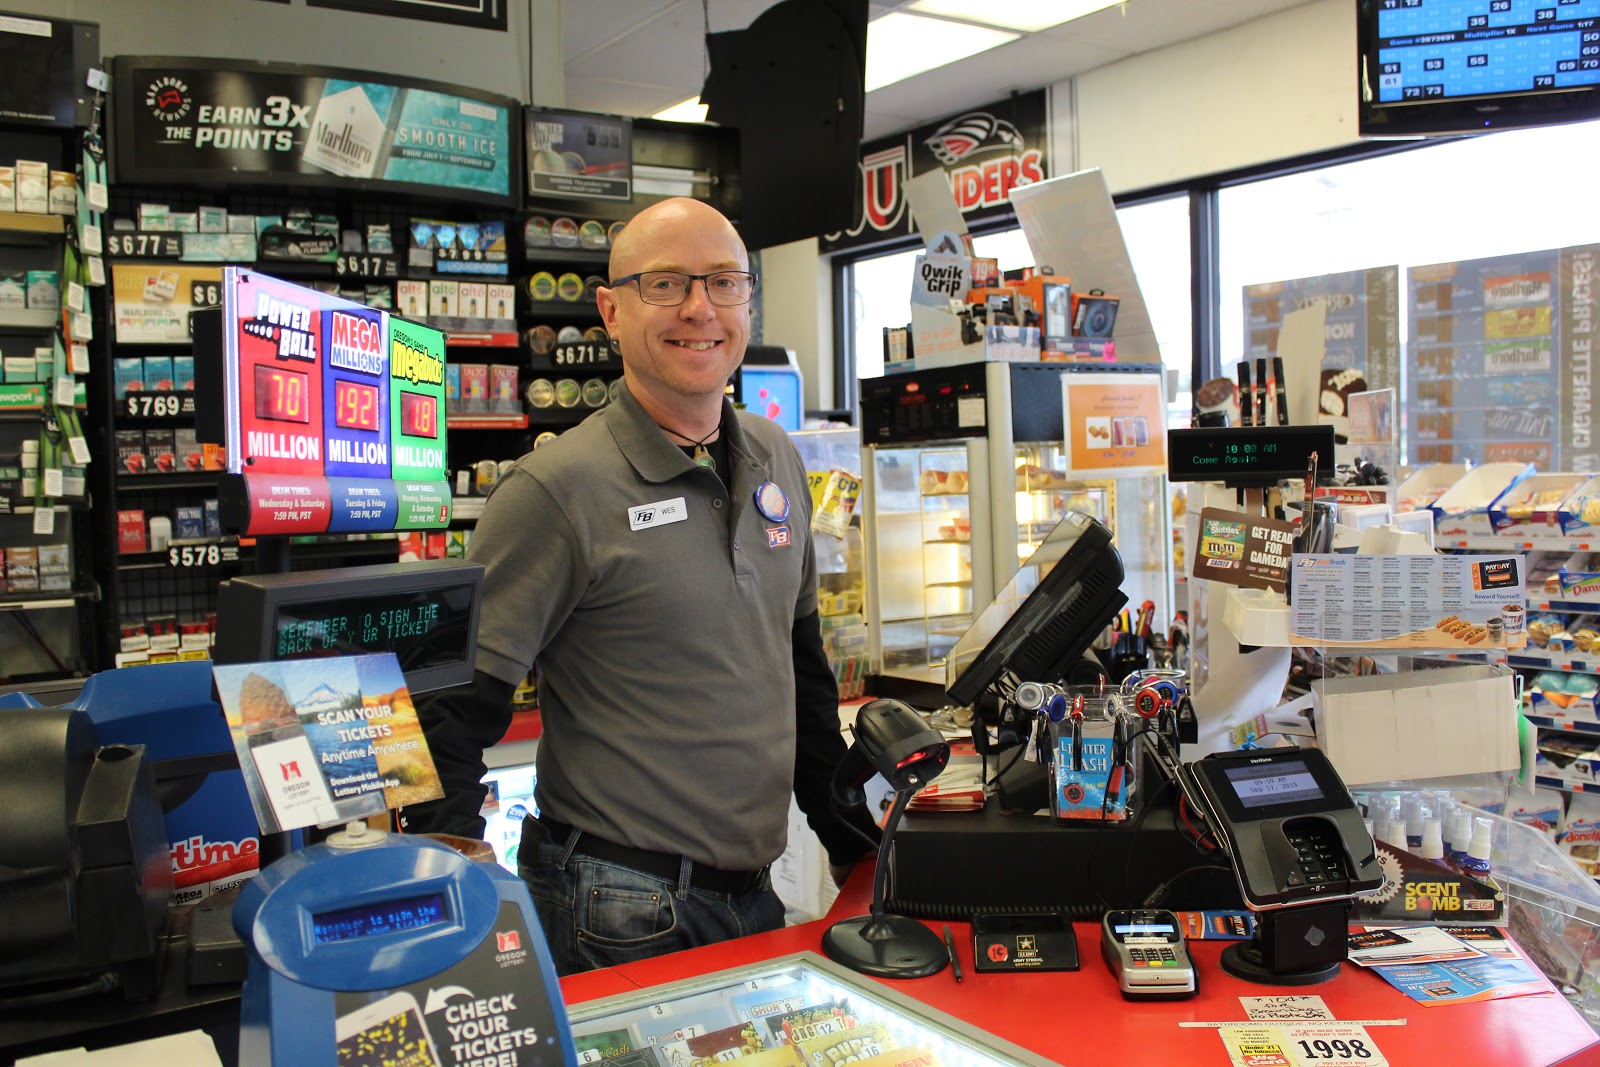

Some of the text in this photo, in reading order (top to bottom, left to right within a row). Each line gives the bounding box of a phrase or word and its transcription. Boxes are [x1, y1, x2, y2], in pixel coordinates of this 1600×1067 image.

[1492, 1, 1508, 11] 26
[1470, 10, 1552, 26] 35 38
[1389, 38, 1414, 47] Game
[1464, 29, 1504, 40] Multiplier
[1526, 24, 1546, 33] Next
[1549, 22, 1574, 31] Game
[1577, 20, 1594, 28] 1:17
[1583, 33, 1600, 42] 50
[1582, 46, 1599, 55] 60
[1384, 56, 1598, 73] 51 53 55 69 70
[1385, 76, 1552, 97] 61 72 73 78
[198, 105, 261, 126] EARN
[432, 117, 473, 131] ONLY ON
[165, 126, 293, 151] THE POINTS
[316, 121, 373, 164] Marlboro
[400, 129, 496, 156] SMOOTH ICE
[402, 149, 482, 167] FROM JULY SEPTEMBER
[108, 235, 161, 256] $6.77
[337, 255, 381, 276] $6.17
[921, 263, 963, 281] Qwik
[399, 281, 425, 295] alto
[432, 282, 456, 296] alto
[461, 283, 485, 297] alto
[489, 284, 513, 299] alto
[927, 278, 961, 297] Grip
[123, 308, 162, 317] MARLBORO
[257, 293, 311, 332] POWER
[333, 312, 381, 355] MEGA
[394, 329, 425, 350] OREGON'S GAME
[279, 329, 316, 360] BALL
[331, 348, 382, 374] MILLIONS
[556, 346, 594, 364] $6.71
[272, 374, 300, 416] 70
[128, 396, 180, 416] $7.69
[338, 388, 373, 425] 192
[247, 431, 319, 461] MILLION
[328, 438, 387, 465] MILLION
[1264, 444, 1277, 453] AM
[394, 445, 443, 468] MILLION
[1193, 456, 1258, 465] Come Again
[271, 486, 312, 495] DRAW TIMES:
[348, 487, 381, 496] DRAW TIMES:
[258, 499, 325, 510] Wednesday & Saturday
[345, 499, 386, 509] Tuesday Friday
[419, 495, 442, 504] Wednesday
[273, 511, 312, 521] 7:59 PM, PST
[350, 510, 381, 519] 7:59 PM, PST
[416, 505, 434, 513] Saturday
[661, 506, 676, 515] WES
[427, 515, 435, 523] PST
[769, 530, 788, 544] FB
[1210, 526, 1240, 535] Skittles
[1251, 526, 1270, 541] GET
[1264, 541, 1283, 555] FOR
[169, 545, 220, 567] $5.78
[1485, 563, 1510, 571] PAYDAY
[279, 604, 439, 639] REMEMBER SIGN THE
[121, 639, 148, 648] Winston
[151, 638, 177, 647] Winston
[183, 637, 208, 646] Winston
[278, 620, 431, 656] BACK OF TICKET
[317, 704, 393, 727] SCAN YOUR
[337, 723, 393, 744] TICKETS
[321, 738, 419, 765] Anytime Anywhere
[330, 771, 378, 787] Download the
[1253, 777, 1276, 785] 09:59
[282, 780, 311, 794] OREGON
[334, 778, 400, 798] Lottery Mobile App
[1266, 784, 1278, 792] 17,
[508, 808, 526, 818] ZYN
[1405, 882, 1460, 896] SCENT
[1479, 901, 1493, 910] USA
[314, 905, 436, 935] Remember to sign the
[495, 950, 526, 963] OREGON
[500, 958, 525, 968] LOTTERY
[751, 981, 758, 990] 4
[445, 993, 517, 1024] CHECK
[657, 1004, 663, 1015] 3
[785, 1003, 793, 1013] 8
[447, 1015, 510, 1043] YOUR
[688, 1028, 696, 1038] 7
[820, 1023, 834, 1036] 12
[450, 1027, 538, 1062] TICKETS
[647, 1035, 658, 1046] $2
[605, 1042, 630, 1059] Cash
[722, 1051, 737, 1061] 11
[865, 1045, 880, 1057] 16
[1298, 1039, 1372, 1059] 1998
[583, 1052, 592, 1063] 6
